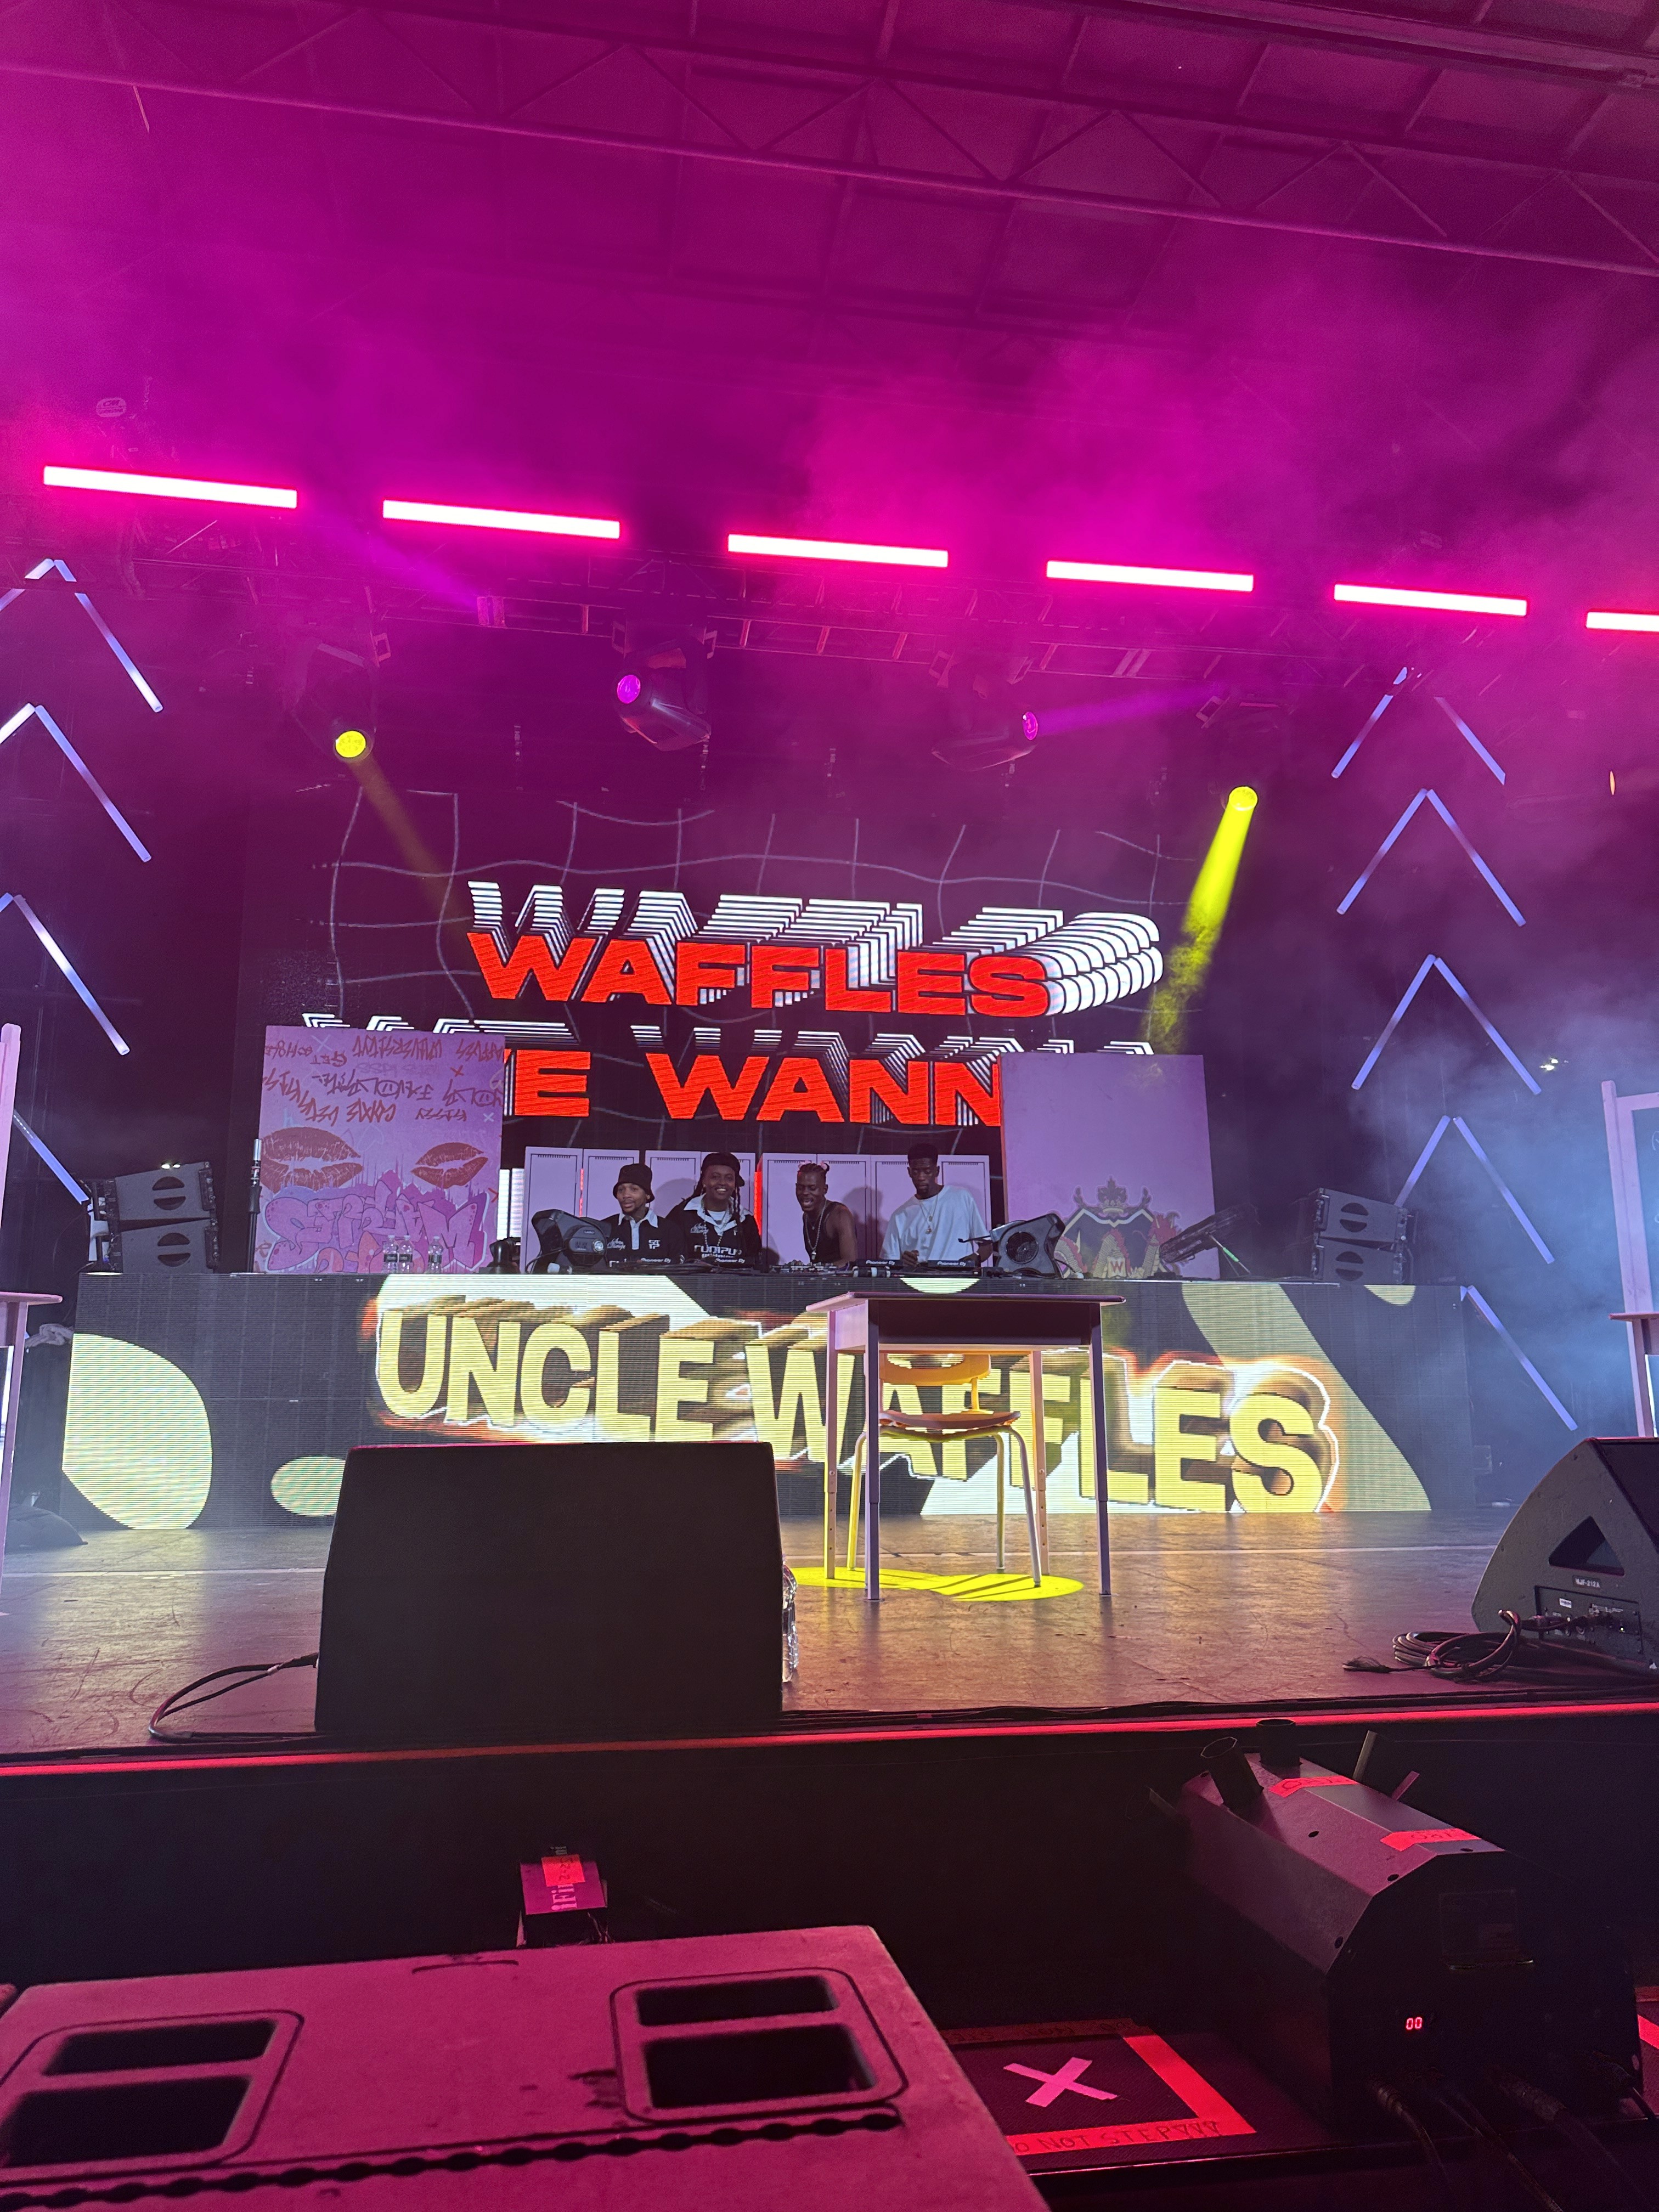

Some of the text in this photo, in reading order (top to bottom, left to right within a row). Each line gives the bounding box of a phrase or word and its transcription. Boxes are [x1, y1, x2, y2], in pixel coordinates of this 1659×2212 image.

[262, 1068, 301, 1103] KIS
[504, 1049, 590, 1117] E
[1110, 1260, 1124, 1273] W
[377, 1306, 1327, 1514] UNCLE WAFFLES
[1405, 2016, 1423, 2031] 00
[1037, 2134, 1091, 2151] NOT
